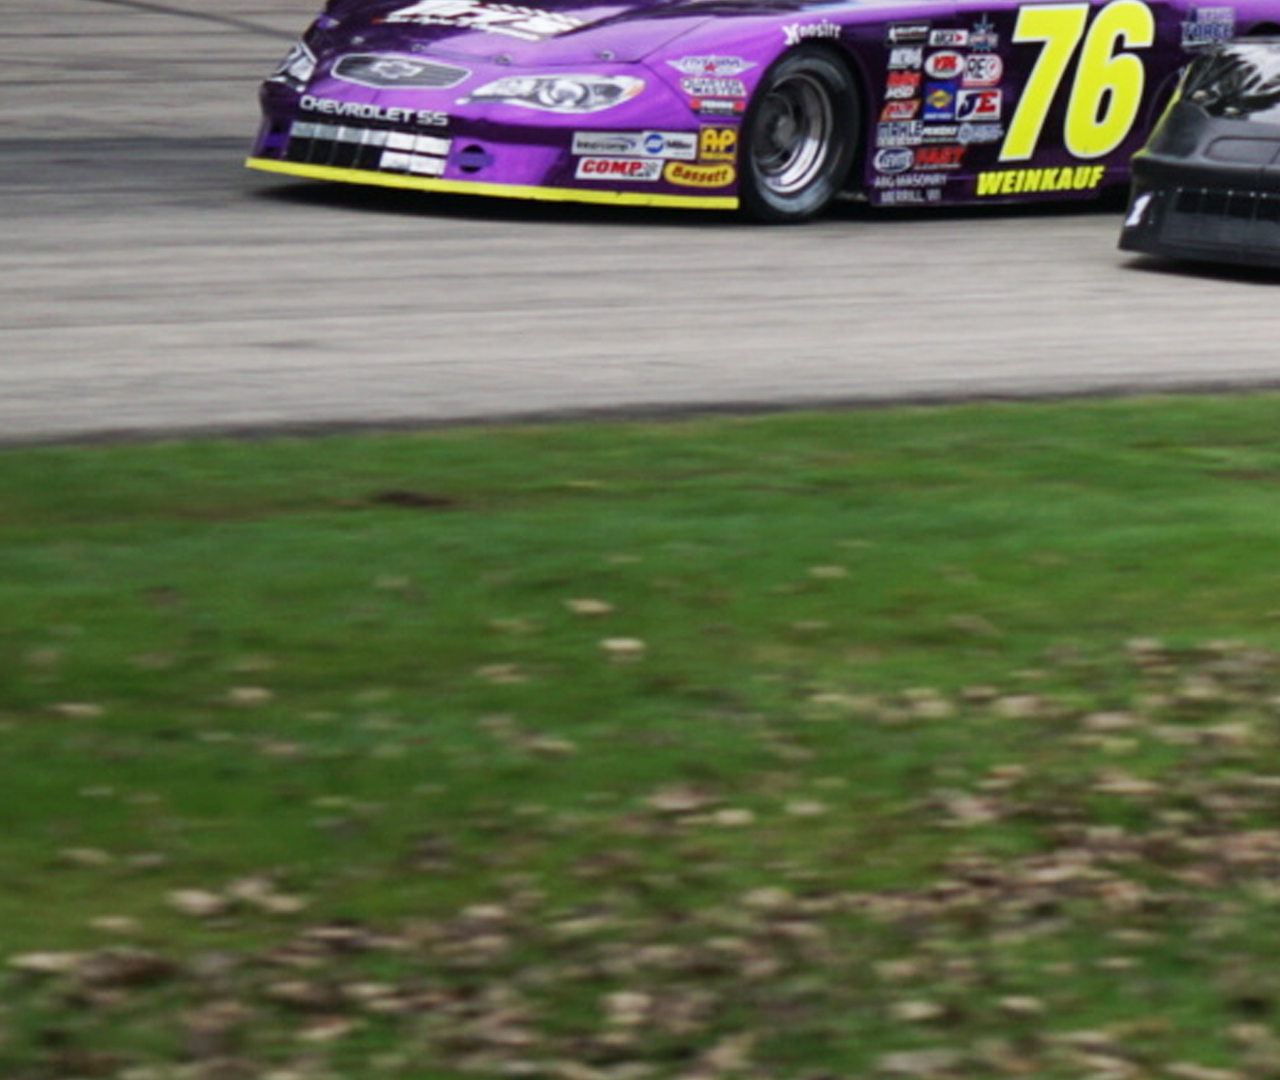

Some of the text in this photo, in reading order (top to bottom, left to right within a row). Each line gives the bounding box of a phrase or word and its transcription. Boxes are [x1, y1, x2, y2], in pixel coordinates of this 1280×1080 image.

[300, 94, 415, 123] CHEVROLET
[957, 91, 998, 118] JE
[582, 159, 642, 174] COMP
[671, 166, 729, 183] Bassett
[976, 165, 1105, 197] WEINKAUF
